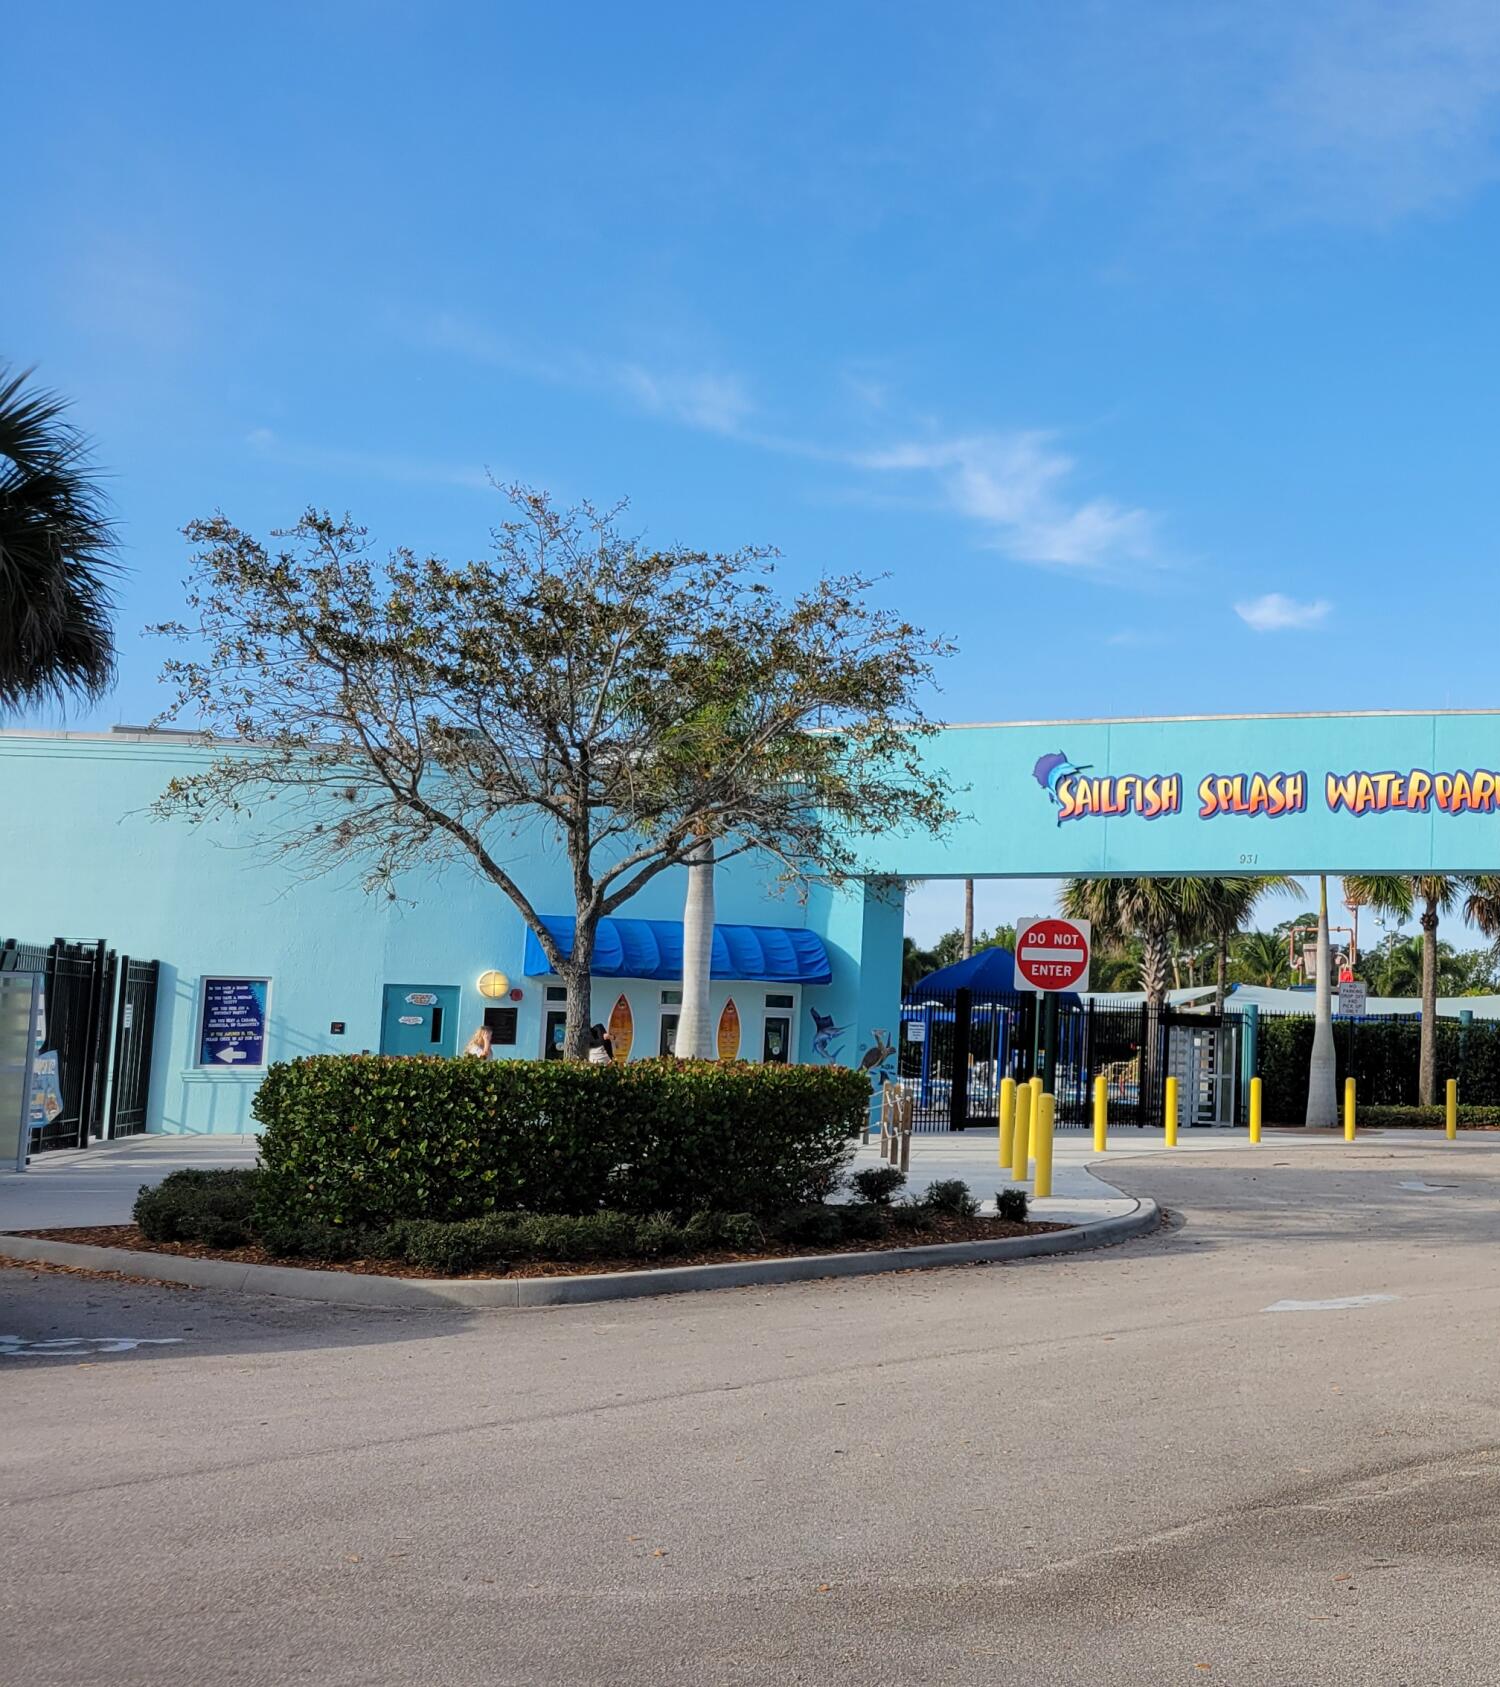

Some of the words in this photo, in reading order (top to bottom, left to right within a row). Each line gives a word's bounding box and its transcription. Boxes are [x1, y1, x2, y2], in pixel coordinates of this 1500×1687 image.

[1057, 773, 1182, 821] SAILFISH
[1198, 770, 1306, 818] SPLASH
[1239, 854, 1258, 864] 931
[1028, 932, 1046, 944] DO
[1053, 934, 1079, 946] NOT
[1031, 964, 1072, 977] ENTER
